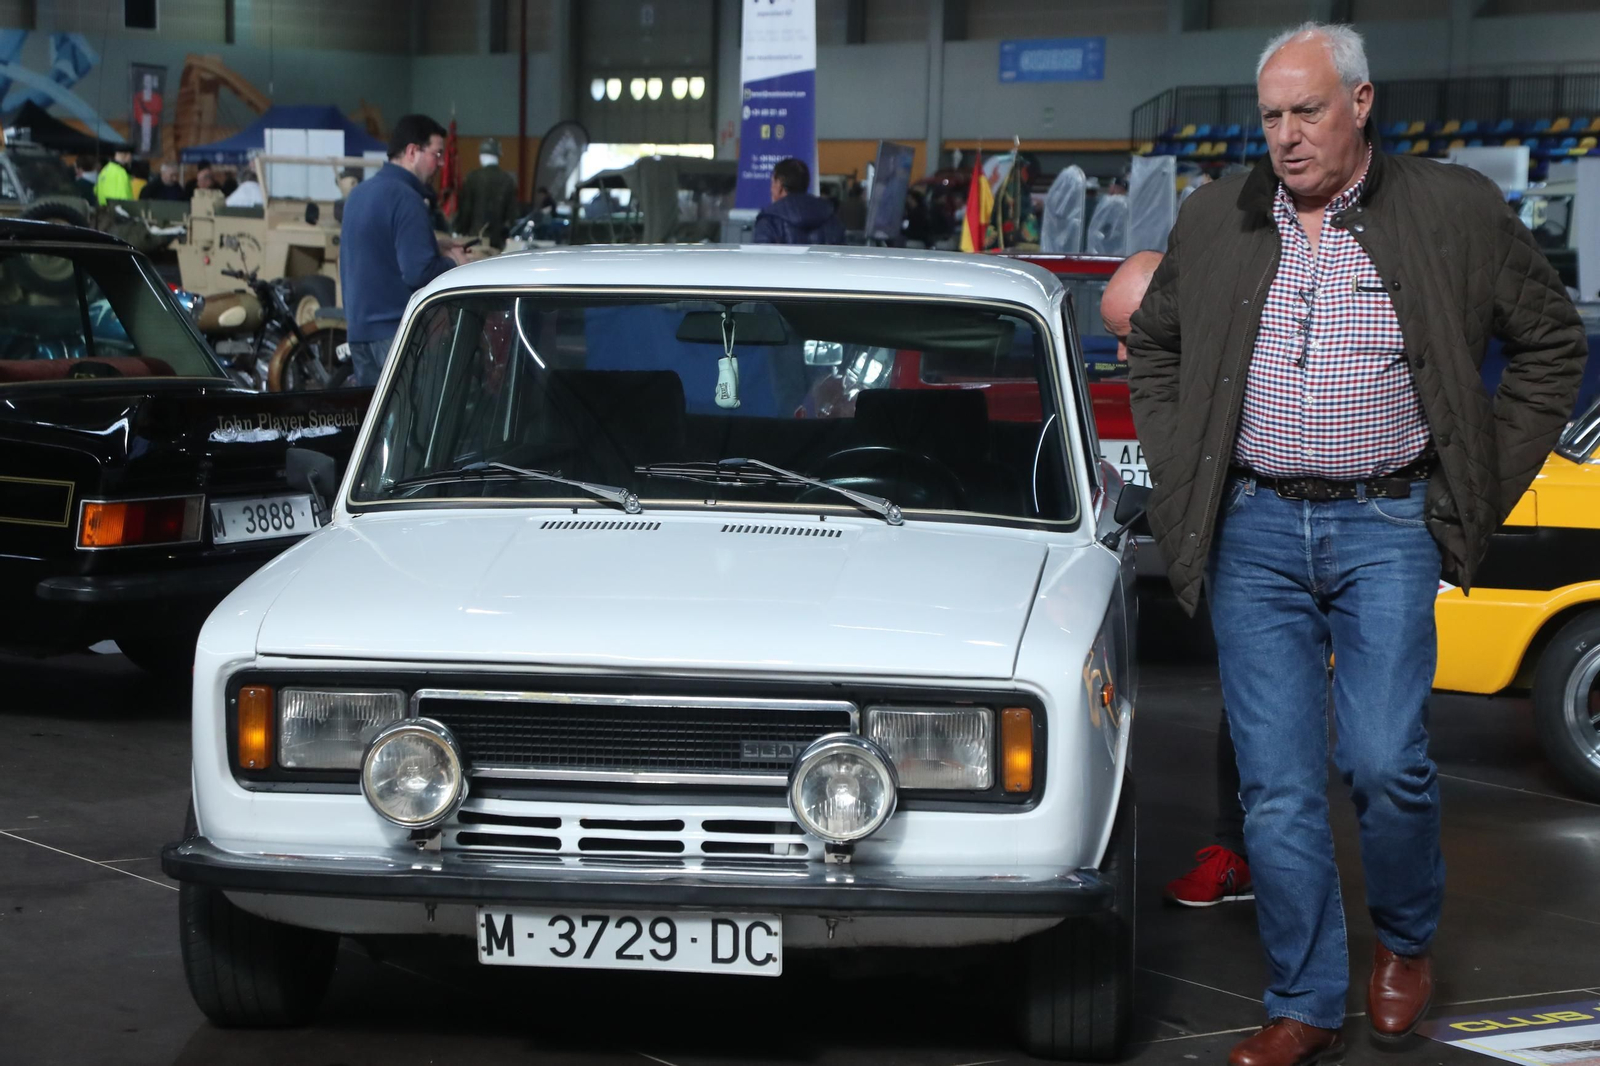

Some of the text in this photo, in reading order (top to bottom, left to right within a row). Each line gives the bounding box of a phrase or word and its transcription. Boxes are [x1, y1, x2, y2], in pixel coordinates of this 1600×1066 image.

[217, 408, 360, 434] John Player Special
[1449, 1010, 1595, 1032] CLUB
